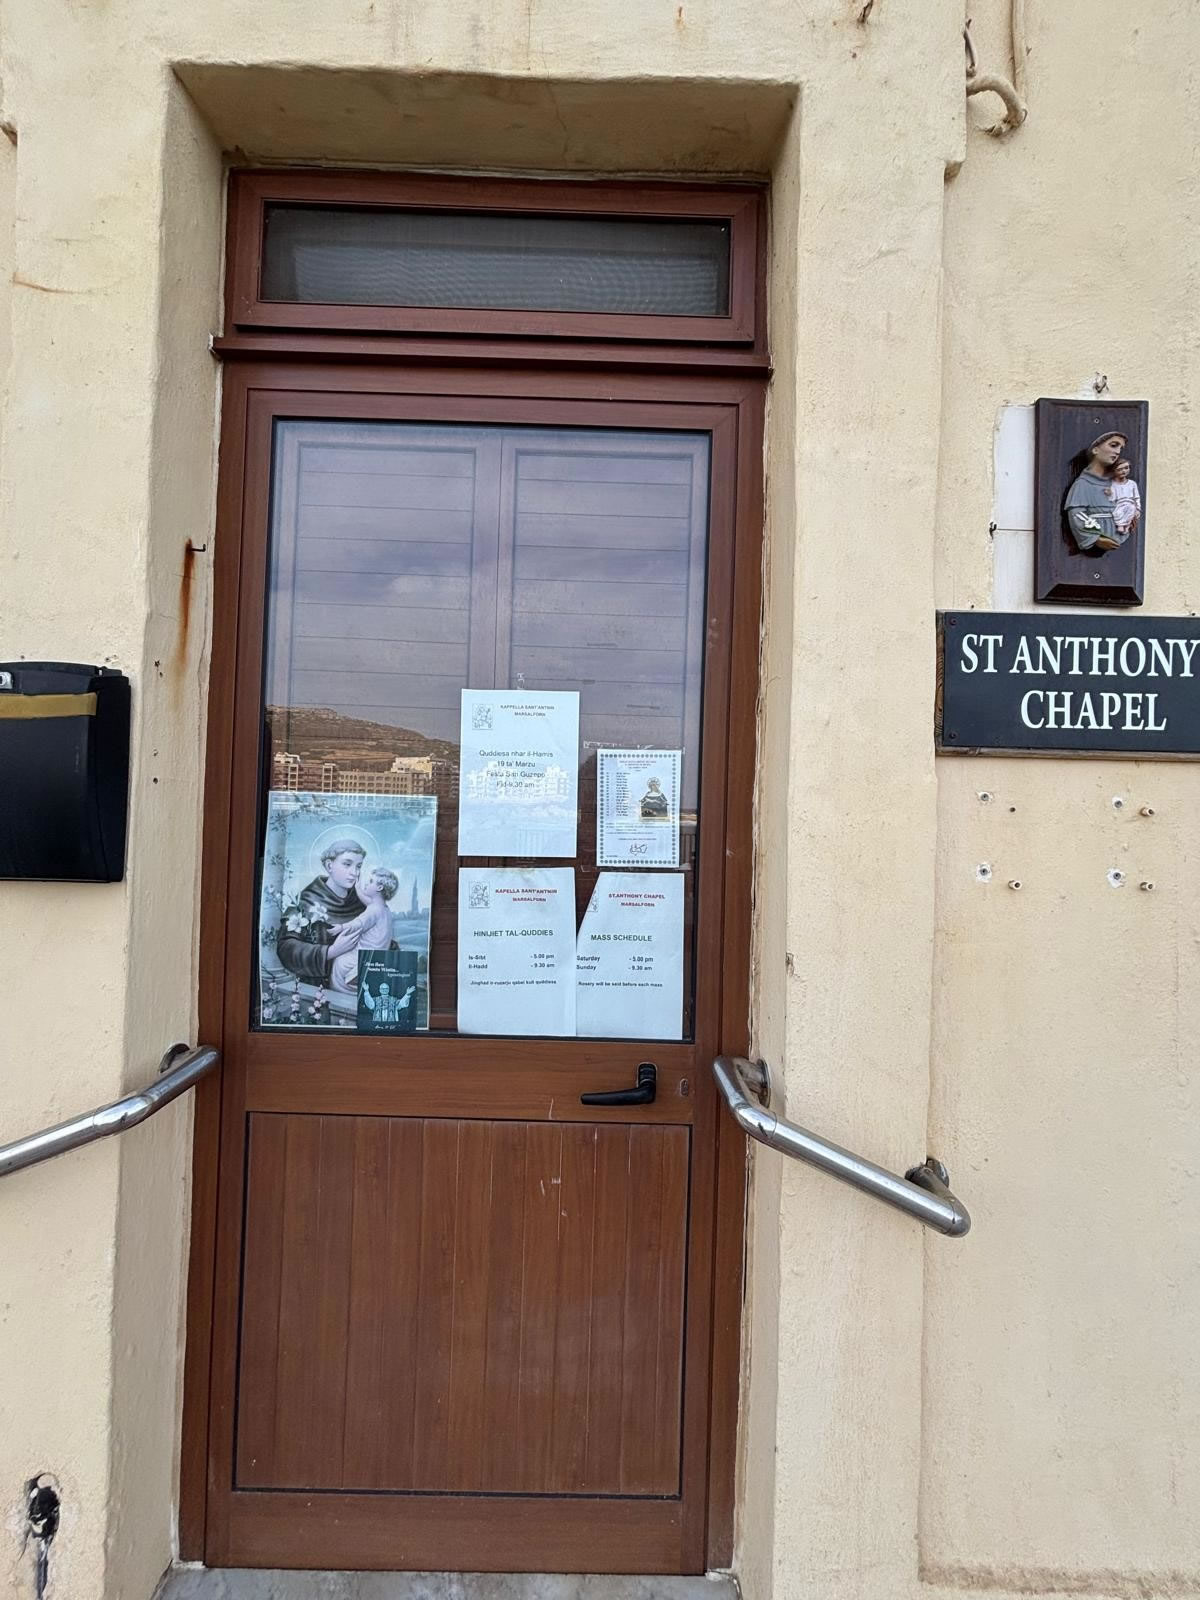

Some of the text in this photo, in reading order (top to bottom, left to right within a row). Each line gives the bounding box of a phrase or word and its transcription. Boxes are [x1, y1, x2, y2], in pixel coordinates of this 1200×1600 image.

[960, 633, 1200, 678] ST ANTHONY
[1020, 689, 1168, 732] CHAPEL
[479, 749, 510, 757] Quddiesa
[515, 760, 536, 768] Marzu
[505, 929, 554, 937] TAL-QUDDIES
[613, 934, 653, 942] SCHEDULE
[576, 955, 600, 963] Saturday
